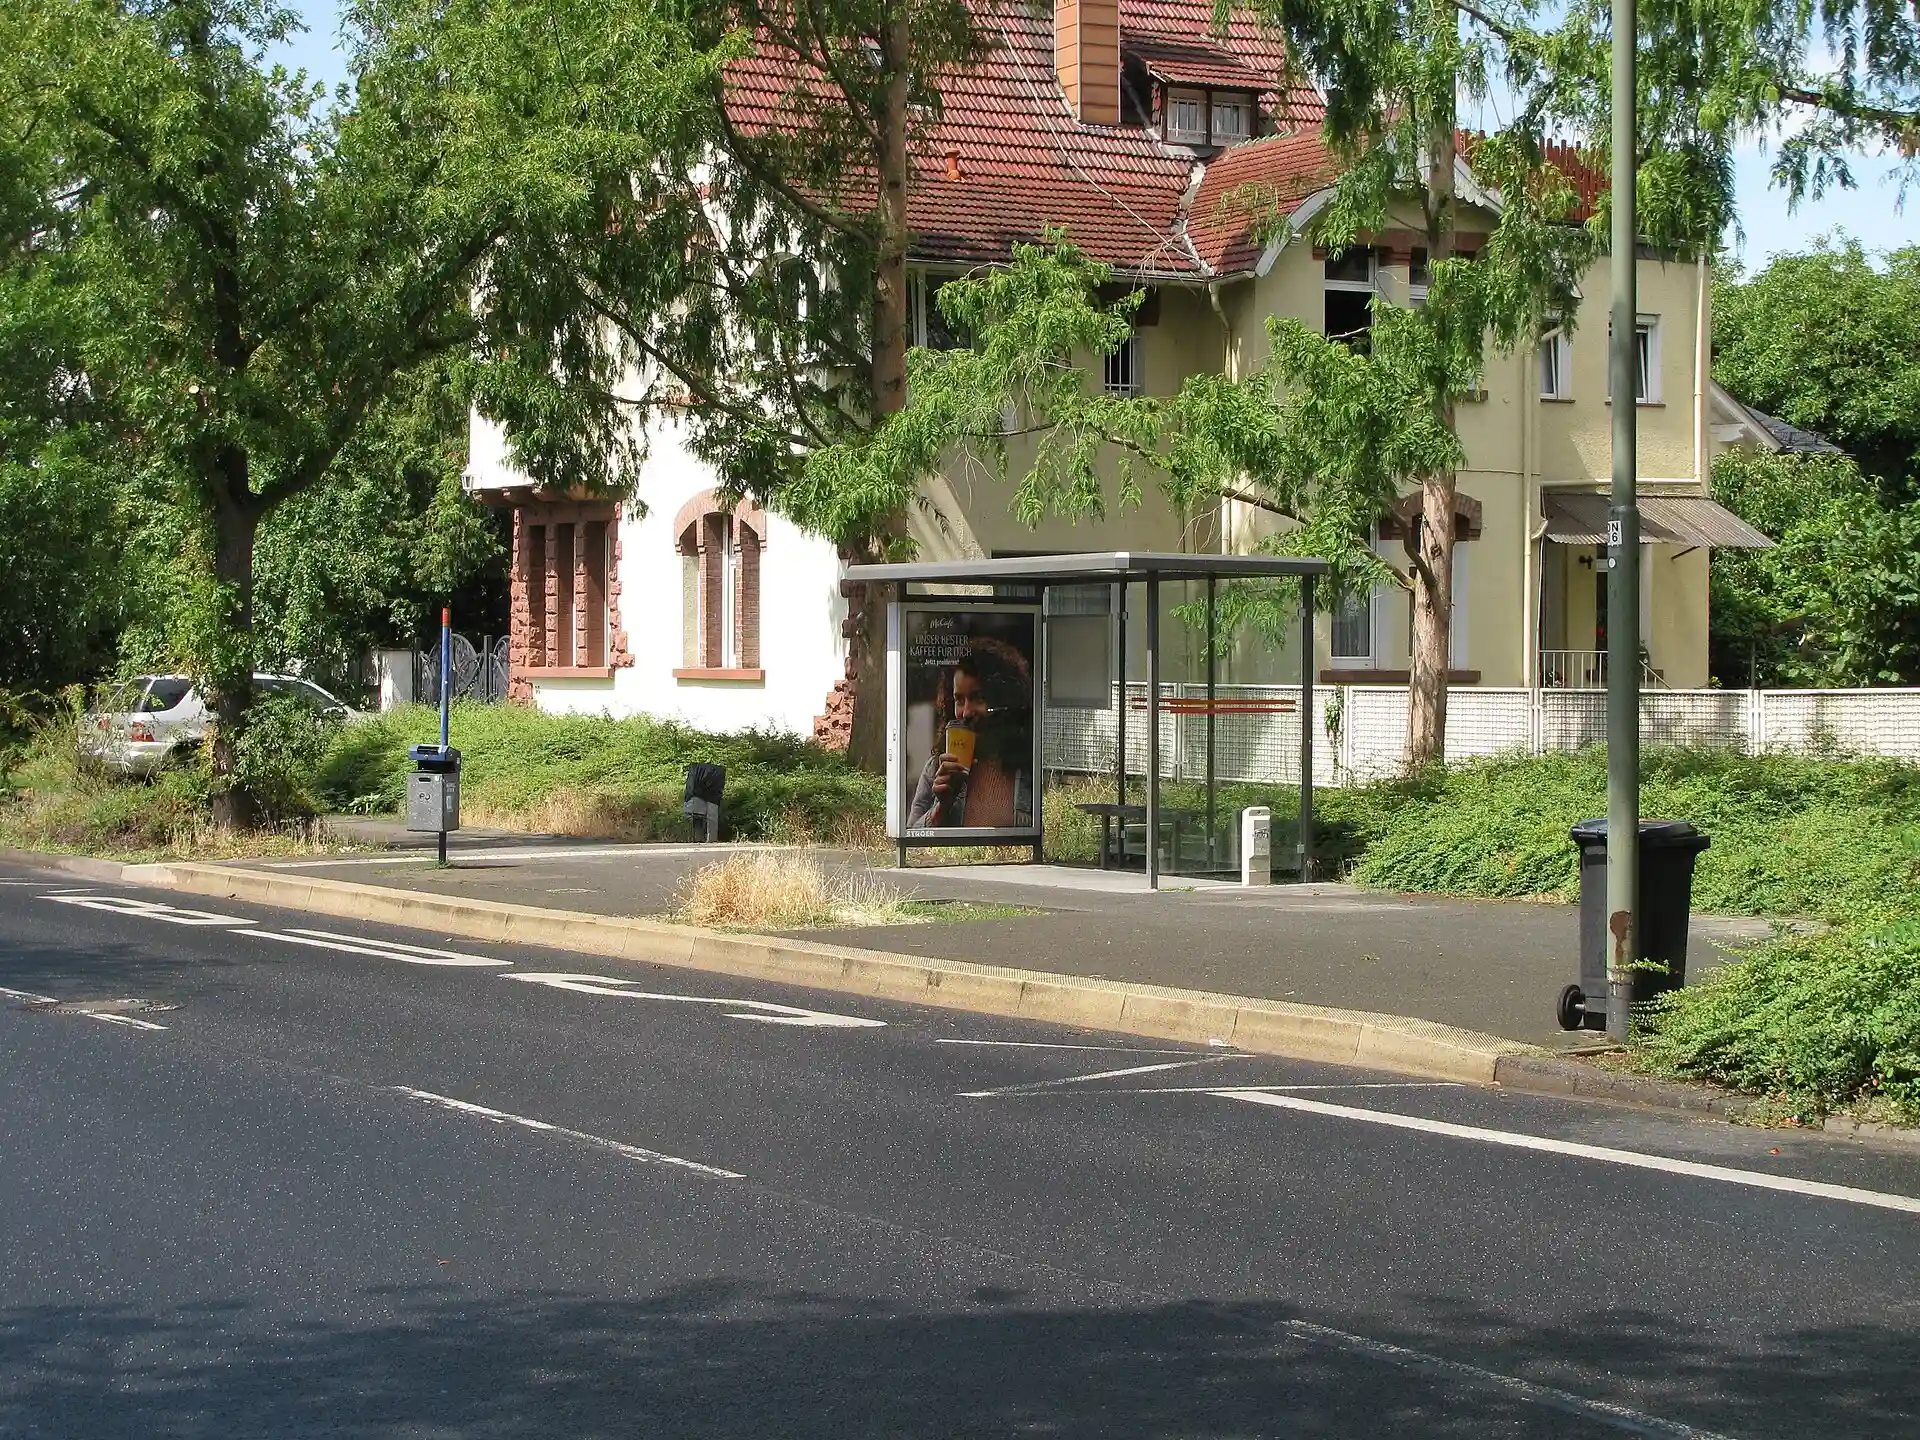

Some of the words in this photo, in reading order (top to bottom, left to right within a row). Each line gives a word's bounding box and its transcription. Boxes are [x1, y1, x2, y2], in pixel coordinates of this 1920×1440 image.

[915, 634, 940, 645] UNSER
[941, 634, 969, 646] BESTER
[909, 645, 936, 657] KAFFEE
[36, 893, 888, 1029] BUS
